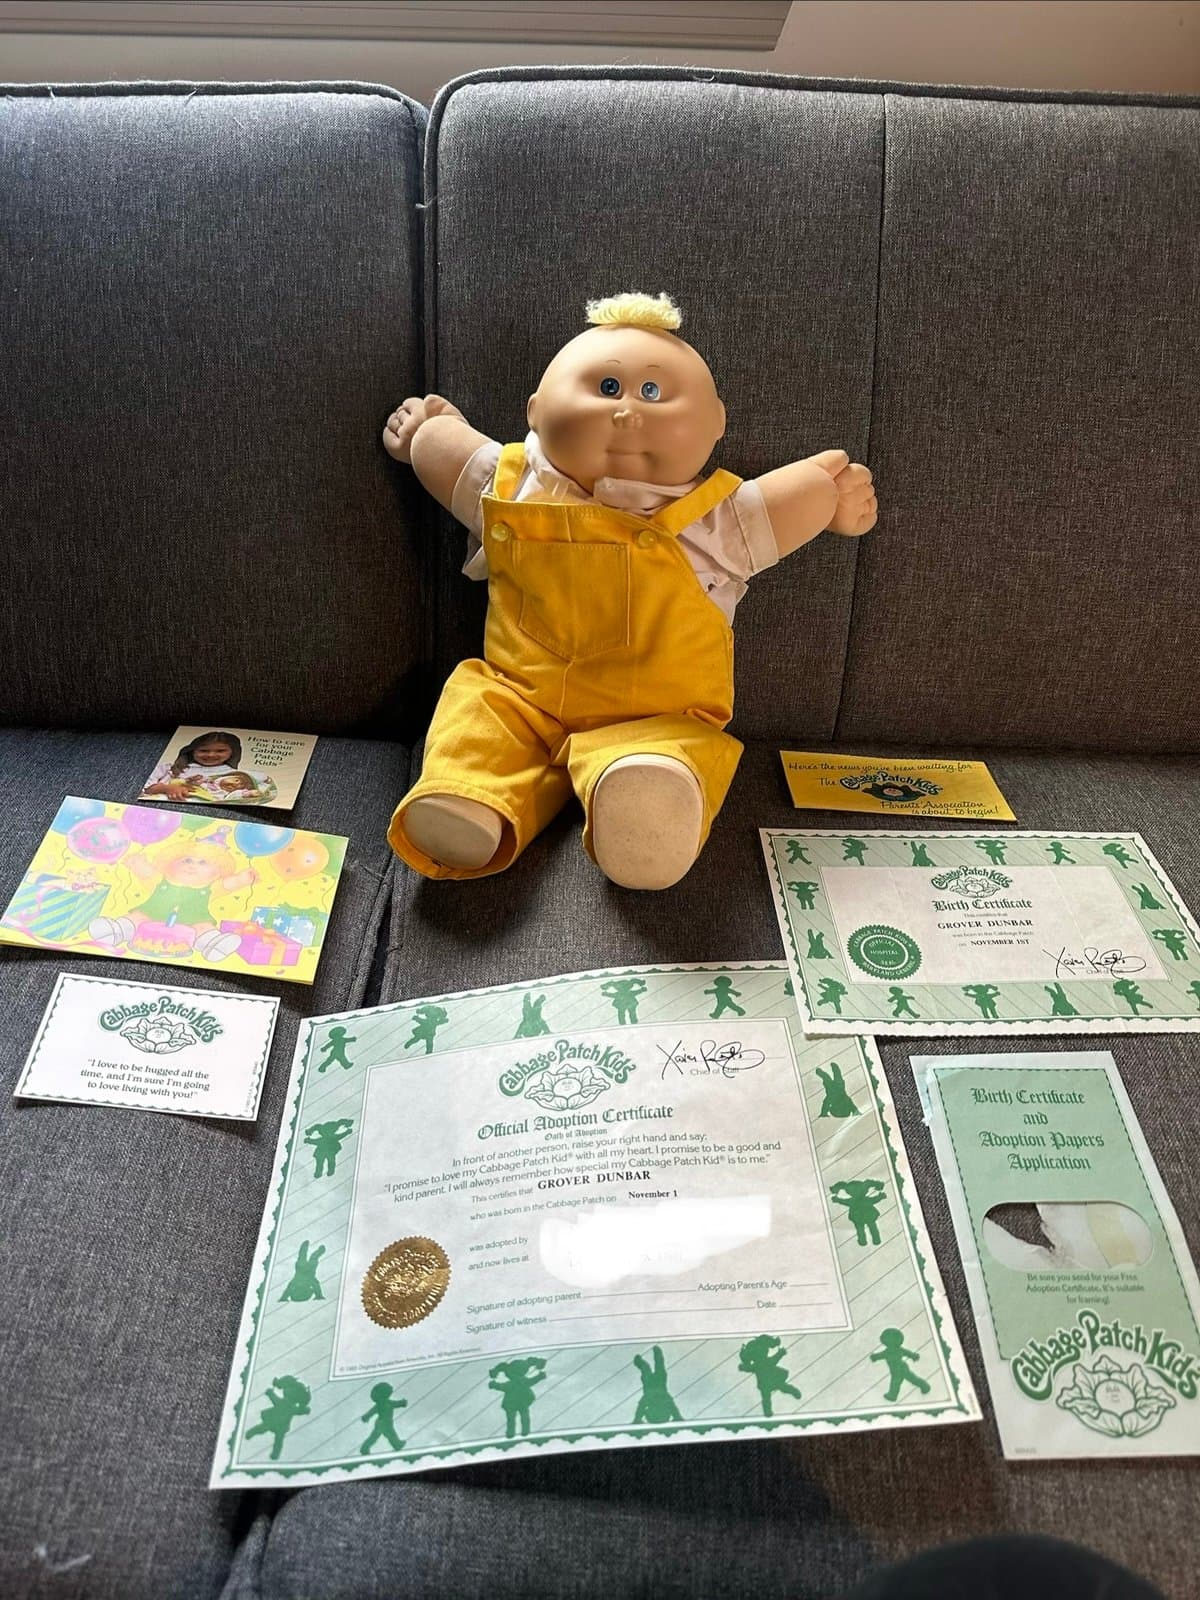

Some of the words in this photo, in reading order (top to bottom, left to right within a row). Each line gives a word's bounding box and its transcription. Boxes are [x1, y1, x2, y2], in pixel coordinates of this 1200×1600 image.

[251, 747, 294, 756] Cabbage
[254, 753, 283, 761] Patch
[821, 762, 834, 770] the
[917, 763, 955, 773] waiting
[818, 777, 836, 786] The
[877, 770, 913, 784] Patch
[912, 778, 943, 796] Kids
[921, 808, 950, 816] about
[955, 808, 965, 816] to
[967, 805, 999, 818] begin!
[923, 800, 985, 809] Association
[959, 865, 989, 878] Patch
[988, 870, 1013, 888] Kids
[932, 900, 969, 912] Birth
[972, 899, 1033, 910] Certificate
[937, 920, 982, 929] GROVER
[987, 919, 1033, 927] DUNBAR
[99, 1001, 158, 1031] Cabbage
[157, 996, 196, 1023] Patch
[188, 1011, 223, 1043] Kids
[98, 1059, 118, 1069] love
[119, 1062, 130, 1071] to
[131, 1063, 144, 1072] be
[145, 1066, 180, 1079] hugged
[181, 1067, 193, 1078] all
[195, 1070, 210, 1080] the
[499, 1051, 557, 1097] Cabbage
[555, 1039, 601, 1063] Patch
[599, 1045, 636, 1083] Kids
[80, 1069, 104, 1080] time,
[106, 1072, 125, 1081] and
[126, 1073, 142, 1083] I'm
[143, 1077, 165, 1085] sure
[166, 1077, 182, 1087] I'm
[183, 1080, 210, 1092] going
[87, 1081, 97, 1089] to
[99, 1081, 120, 1091] love
[122, 1083, 148, 1096] living
[150, 1087, 171, 1097] with
[172, 1090, 199, 1100] you!"
[970, 1087, 1013, 1105] Birth
[1016, 1088, 1086, 1105] Certificate
[477, 1119, 529, 1140] Official
[533, 1112, 598, 1131] Adoption
[602, 1105, 674, 1123] Certificate
[1023, 1112, 1048, 1125] and
[544, 1132, 564, 1141] Oath
[565, 1130, 573, 1138] of
[574, 1128, 608, 1137] Adoption
[979, 1131, 1046, 1148] Adoption
[1049, 1132, 1105, 1150] Papers
[452, 1158, 461, 1167] In
[463, 1155, 485, 1166] front
[487, 1153, 496, 1161] of
[497, 1148, 533, 1160] another
[535, 1144, 570, 1156] person,
[571, 1141, 594, 1150] raise
[596, 1138, 617, 1150] your
[619, 1135, 641, 1147] right
[643, 1133, 667, 1143] hand
[669, 1132, 688, 1142] and
[689, 1133, 708, 1143] say:
[392, 1178, 430, 1195] promise
[431, 1176, 441, 1186] to
[442, 1172, 461, 1183] love
[462, 1169, 478, 1181] my
[479, 1160, 522, 1175] Cabbage
[522, 1156, 549, 1168] Patch
[575, 1150, 596, 1160] with
[597, 1149, 608, 1158] all
[609, 1149, 625, 1160] my
[627, 1145, 655, 1156] heart.
[655, 1145, 660, 1154] I
[661, 1144, 700, 1157] promise
[701, 1144, 712, 1153] to
[713, 1142, 727, 1152] be
[727, 1144, 734, 1152] a
[735, 1142, 761, 1154] good
[762, 1141, 781, 1151] and
[1007, 1153, 1092, 1172] Application
[394, 1191, 414, 1203] kind
[415, 1187, 447, 1201] parent.
[453, 1181, 468, 1192] will
[469, 1177, 500, 1189] always
[501, 1169, 552, 1184] remember
[553, 1164, 574, 1175] how
[575, 1160, 609, 1174] special
[611, 1160, 627, 1170] my
[628, 1157, 672, 1168] Cabbage
[674, 1156, 701, 1166] Patch
[728, 1156, 736, 1165] is
[737, 1156, 748, 1164] to
[471, 1195, 487, 1204] This
[489, 1190, 517, 1201] certifies
[519, 1187, 534, 1196] that
[538, 1175, 590, 1190] GROVER
[597, 1170, 652, 1184] DUNBAR
[469, 1211, 486, 1221] who
[487, 1210, 503, 1218] was
[504, 1206, 522, 1216] born
[523, 1205, 531, 1214] in
[532, 1203, 545, 1212] the
[546, 1197, 582, 1210] Cabbage
[582, 1195, 605, 1205] Patch
[628, 1190, 670, 1200] November
[673, 1190, 678, 1198] 1
[469, 1244, 484, 1253] was
[485, 1238, 517, 1250] adopted
[518, 1236, 529, 1246] by
[468, 1260, 484, 1271] and
[485, 1260, 501, 1268] now
[502, 1256, 521, 1265] lives
[522, 1254, 530, 1262] at
[698, 1282, 736, 1293] Adopting
[737, 1280, 770, 1290] Parent's
[770, 1280, 788, 1289] Age
[1026, 1273, 1036, 1281] Be
[1056, 1274, 1071, 1283] you
[1072, 1272, 1090, 1281] send
[1091, 1272, 1102, 1281] for
[1102, 1274, 1120, 1283] your
[1120, 1272, 1138, 1281] Free
[1026, 1284, 1061, 1294] Adoption
[1115, 1284, 1145, 1292] suitable
[466, 1302, 506, 1315] Signature
[506, 1300, 516, 1308] of
[516, 1294, 553, 1306] adopting
[554, 1291, 582, 1303] parent
[757, 1300, 777, 1309] Date
[1066, 1295, 1077, 1304] for
[465, 1320, 505, 1335] Signature
[506, 1318, 516, 1328] of
[516, 1315, 547, 1326] witness
[1012, 1328, 1087, 1400] Cabbage
[1078, 1310, 1147, 1355] Patch
[1145, 1331, 1200, 1399] Kids
